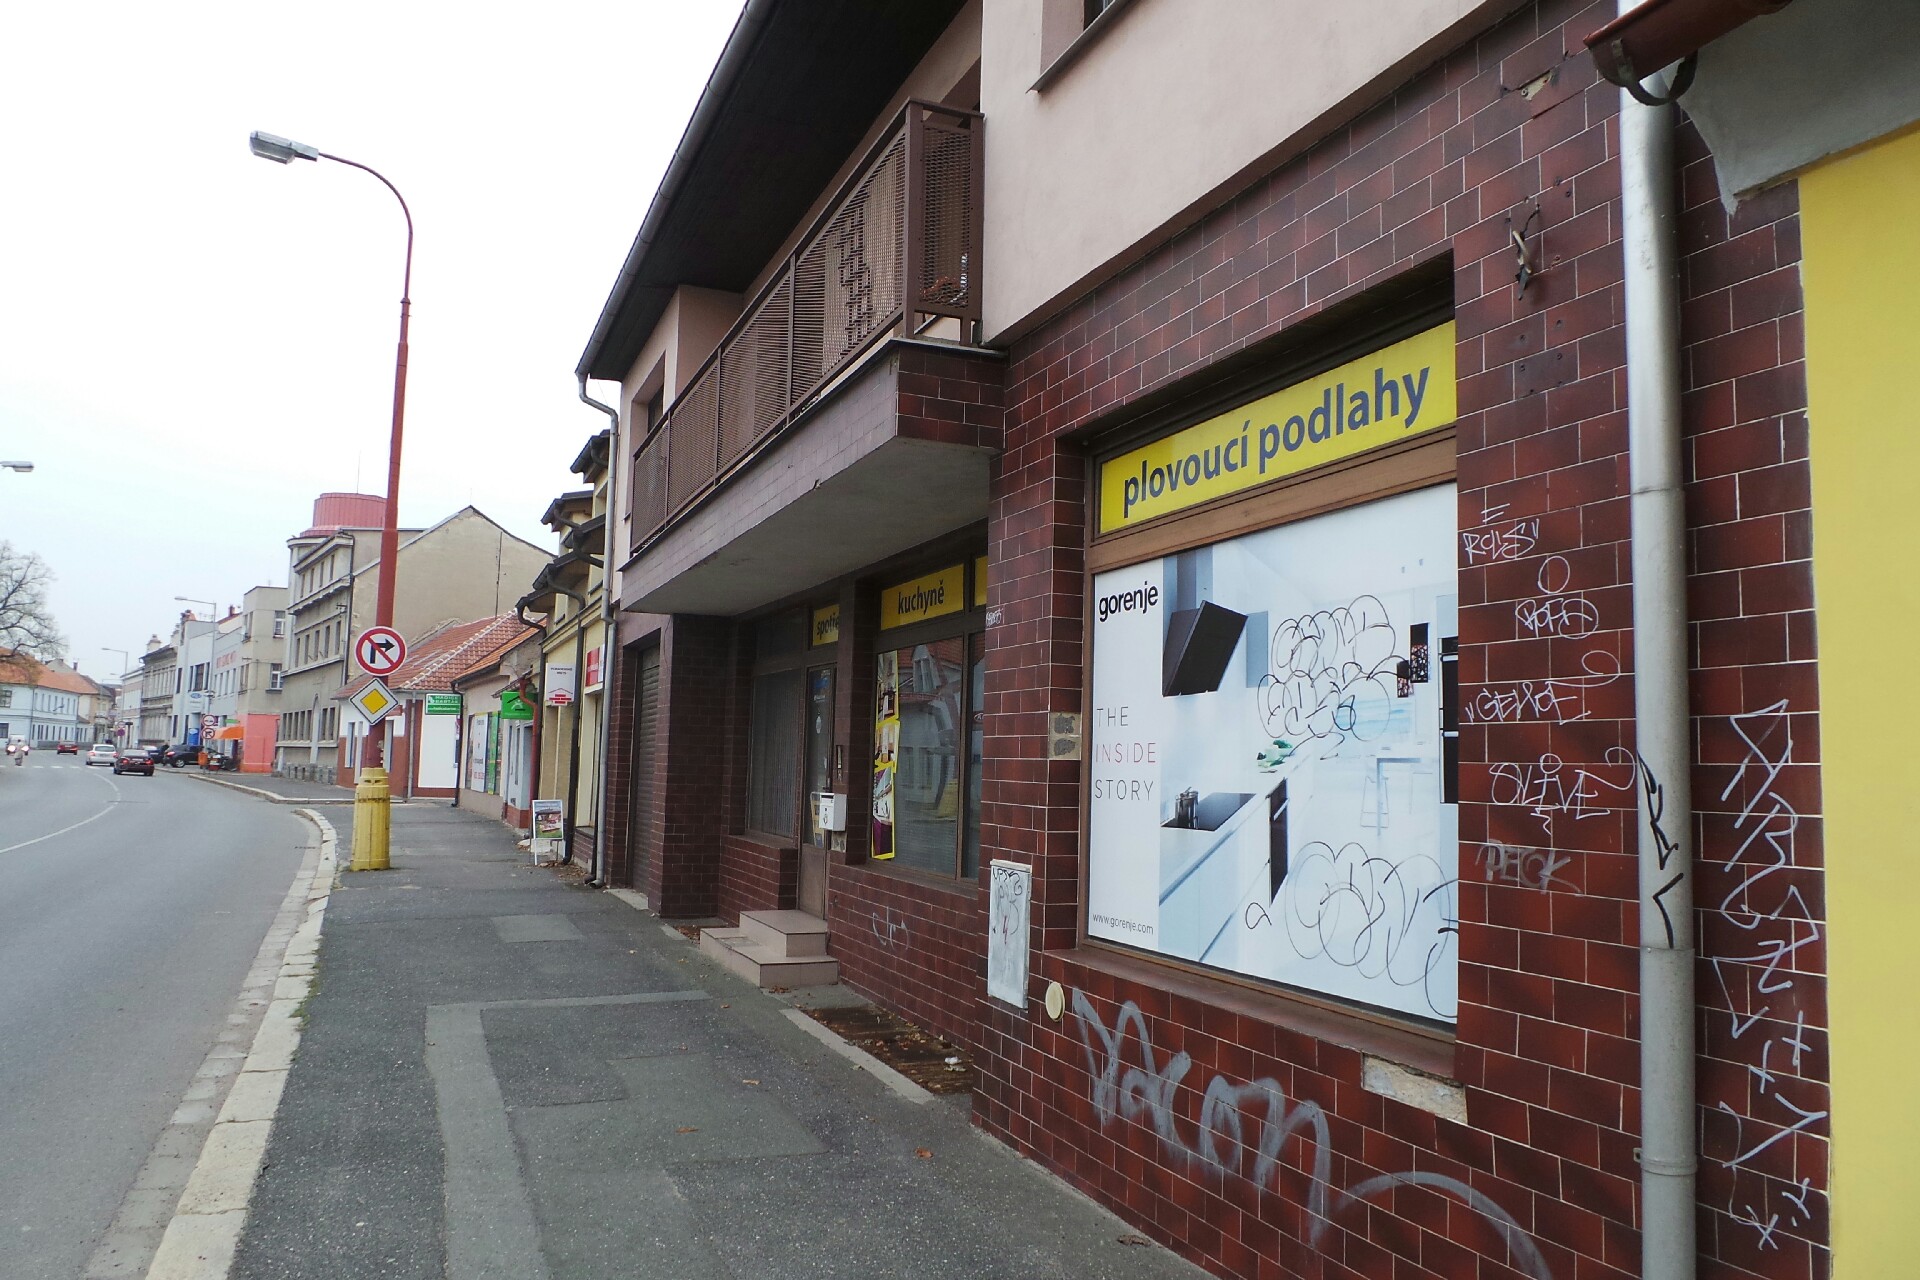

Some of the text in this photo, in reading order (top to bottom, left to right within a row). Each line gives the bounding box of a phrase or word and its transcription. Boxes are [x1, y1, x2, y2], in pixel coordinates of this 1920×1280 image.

[1123, 366, 1430, 518] plovoucí podlahy
[897, 579, 945, 616] kuchyně
[1099, 580, 1159, 622] gorenje
[1096, 706, 1128, 728] THE
[1095, 742, 1156, 763] INSIDE
[1094, 779, 1154, 801] STORY
[1092, 913, 1154, 935] www.gorenje.com
